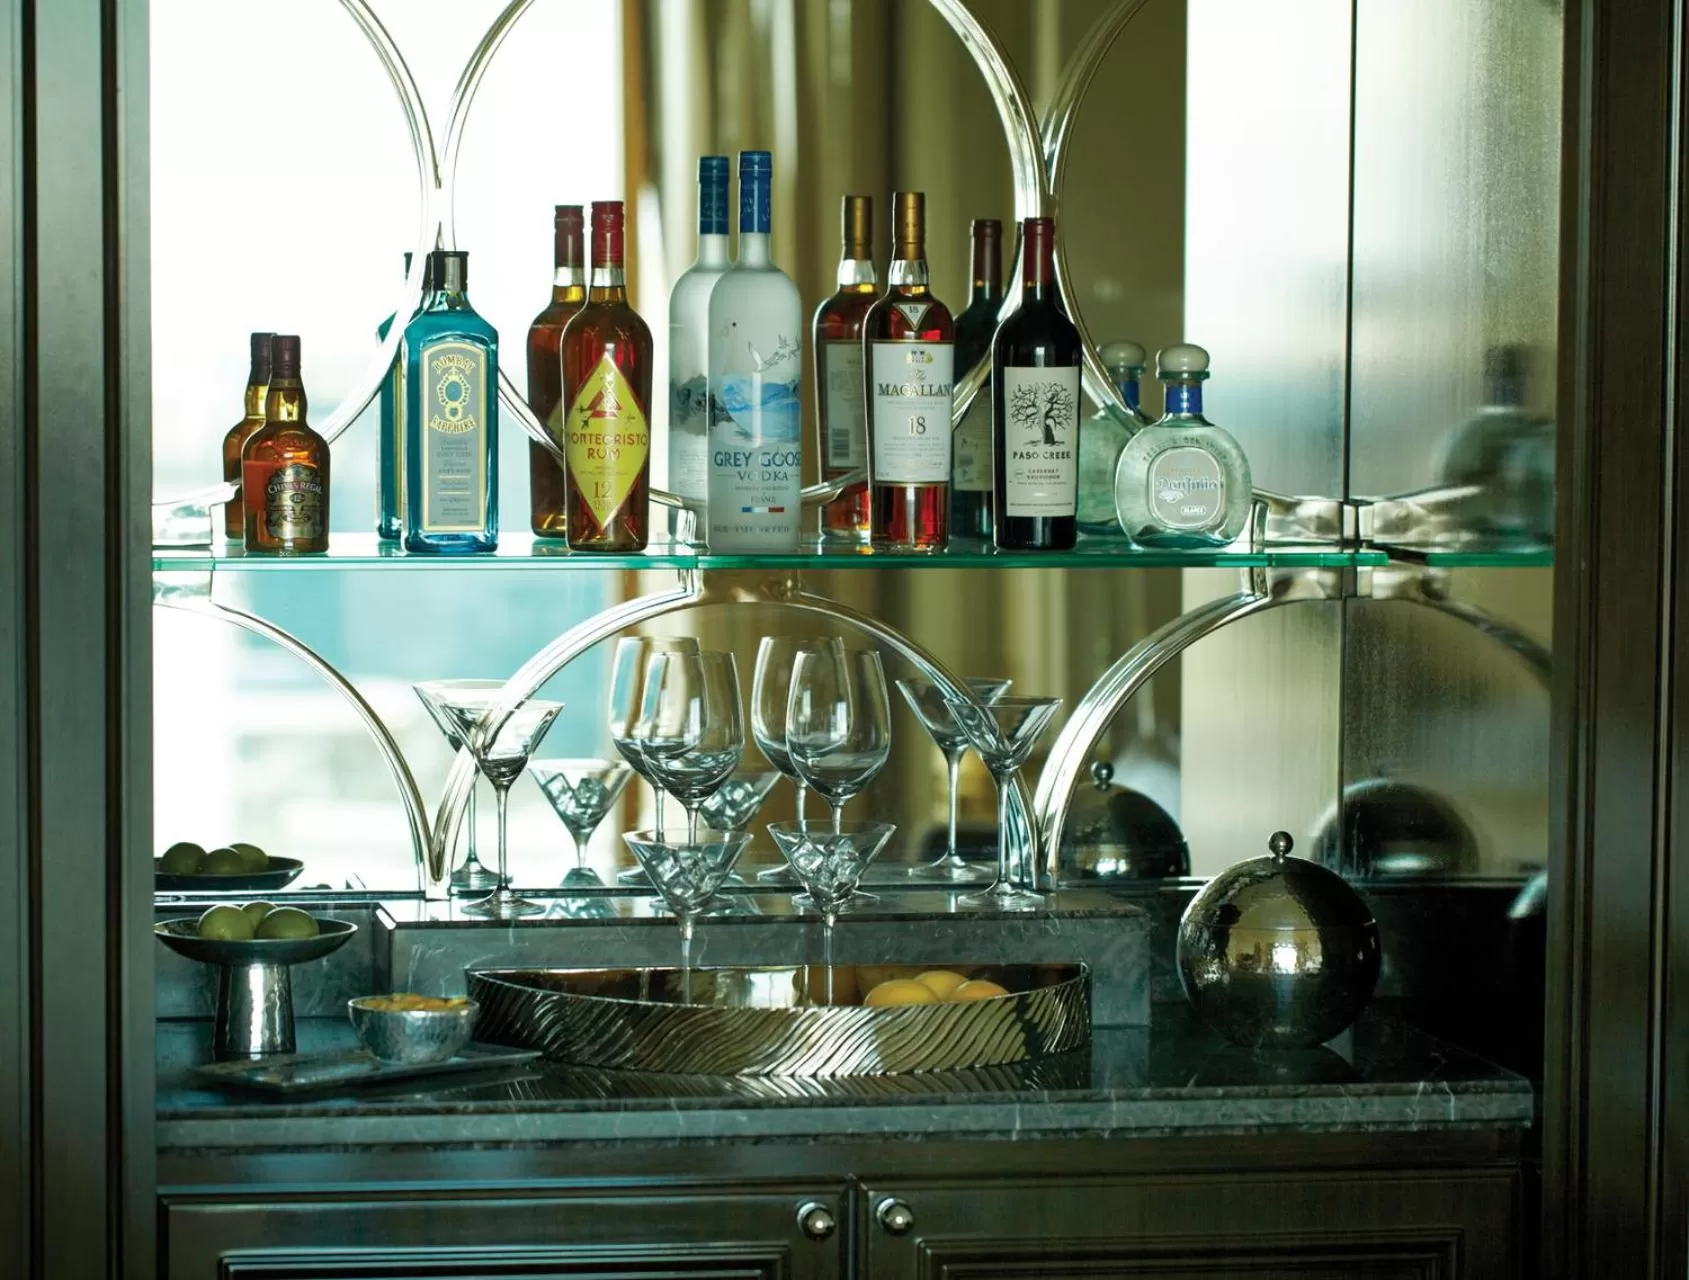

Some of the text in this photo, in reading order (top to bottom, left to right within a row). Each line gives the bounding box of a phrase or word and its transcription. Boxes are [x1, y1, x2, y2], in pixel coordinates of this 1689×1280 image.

[432, 354, 475, 375] BOMBAY
[878, 383, 952, 397] MACALLAN
[430, 414, 476, 434] SAPPHIRE
[909, 415, 926, 434] 18
[714, 451, 752, 468] GREY
[1012, 451, 1072, 460] PASO CREEK
[737, 471, 789, 481] VODKA
[593, 480, 613, 499] 12
